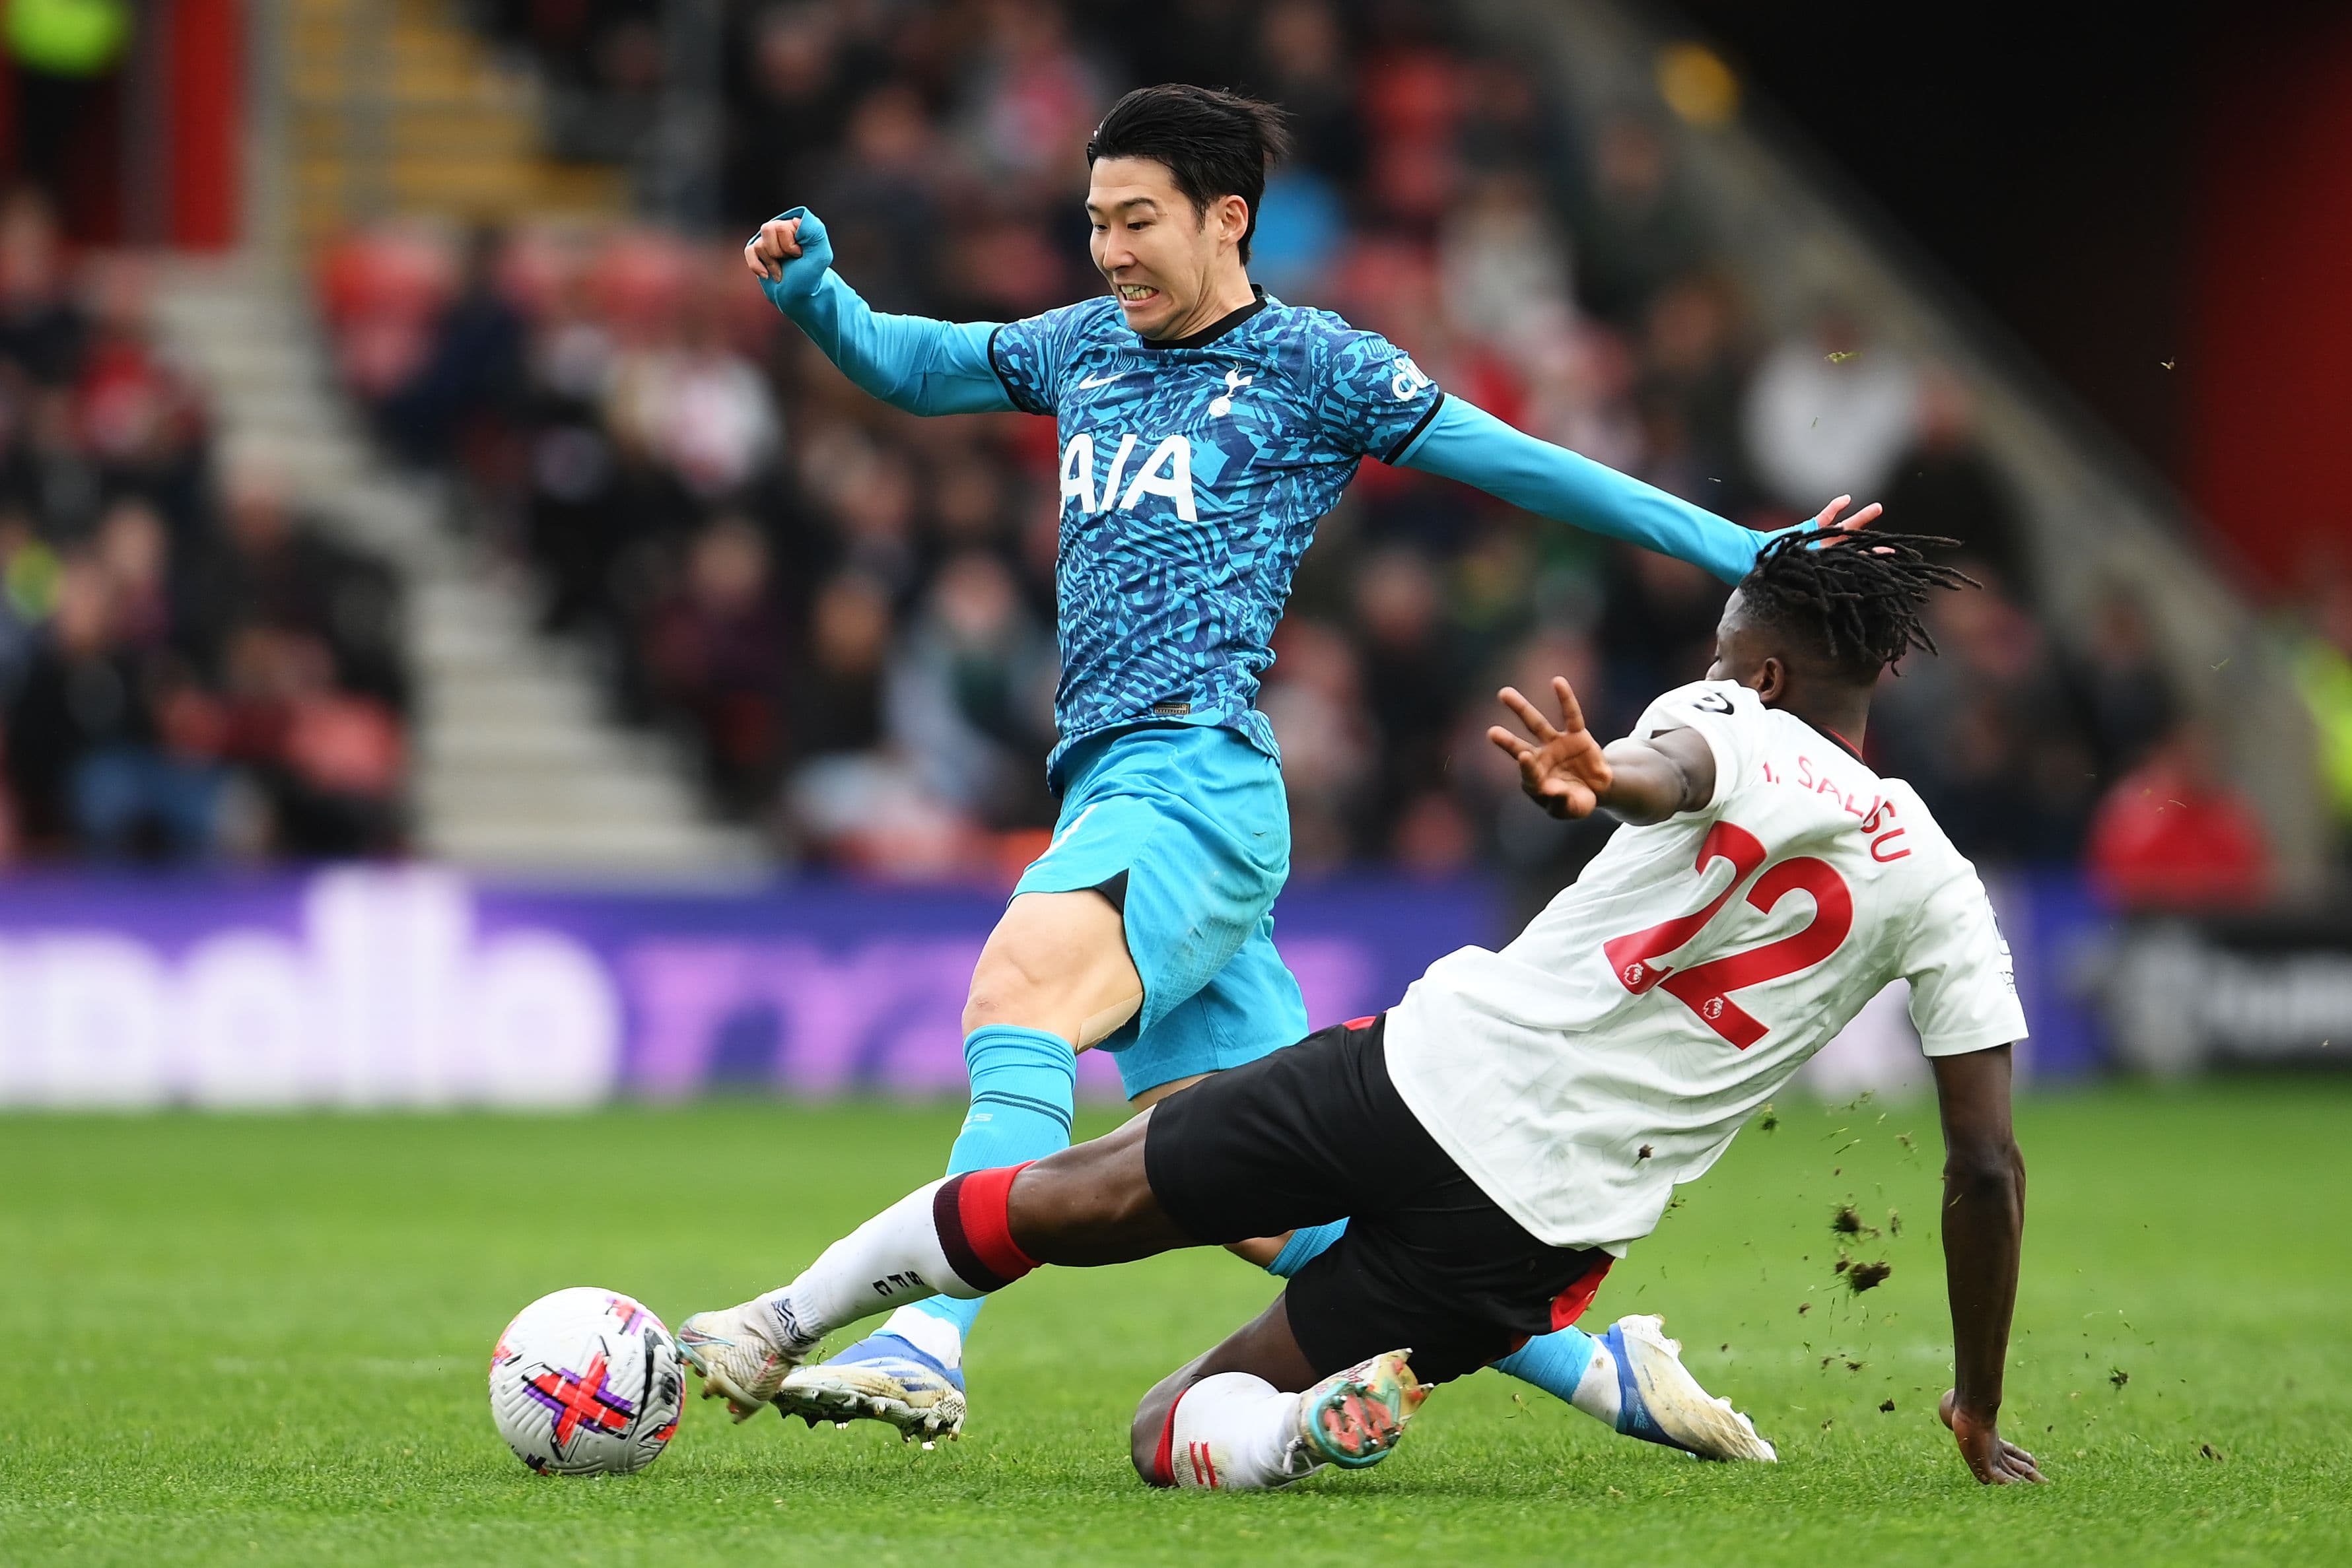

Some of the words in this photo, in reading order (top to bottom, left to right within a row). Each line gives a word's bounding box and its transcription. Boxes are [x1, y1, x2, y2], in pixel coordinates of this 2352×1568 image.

[1059, 433, 1198, 522] AIA
[1798, 755, 1912, 862] SALISU
[1603, 821, 1853, 1050] 22
